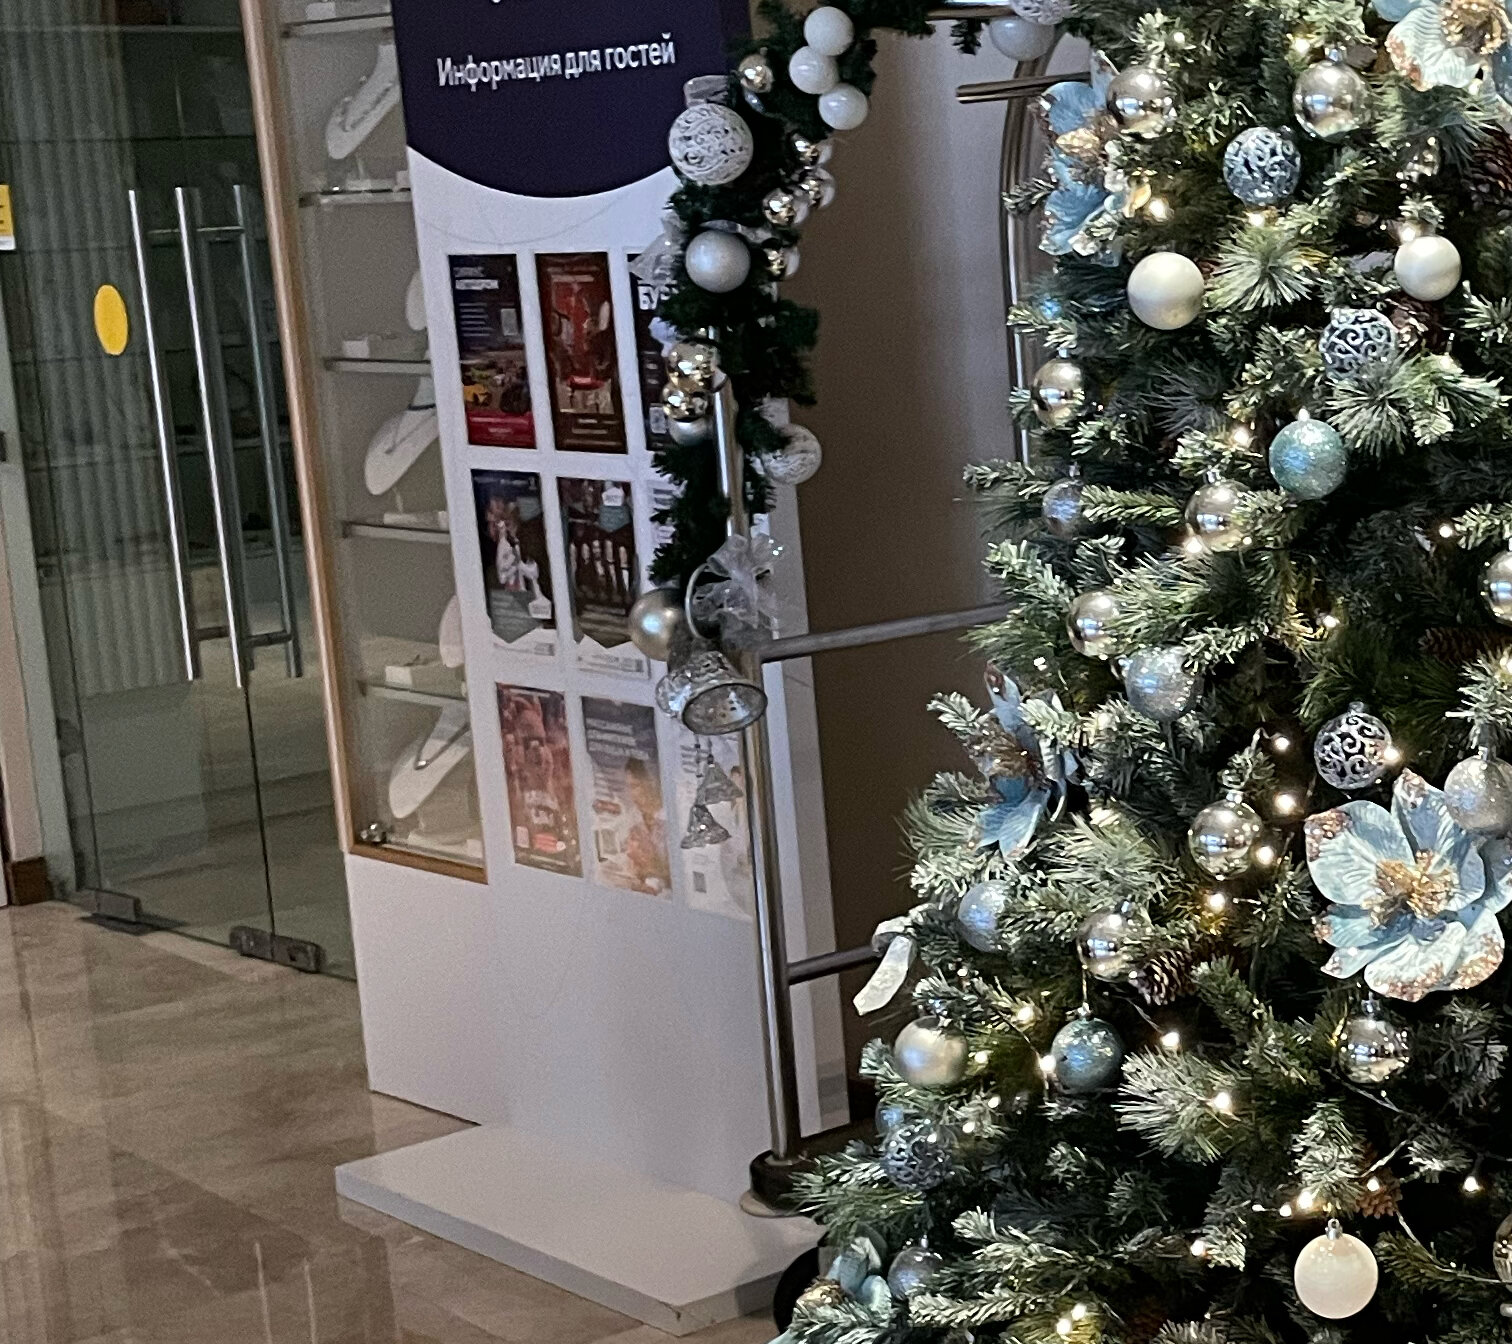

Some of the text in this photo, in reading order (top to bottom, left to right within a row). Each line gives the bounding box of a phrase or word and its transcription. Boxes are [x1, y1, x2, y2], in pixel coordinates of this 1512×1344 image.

[436, 32, 676, 92] Информация для гостей
